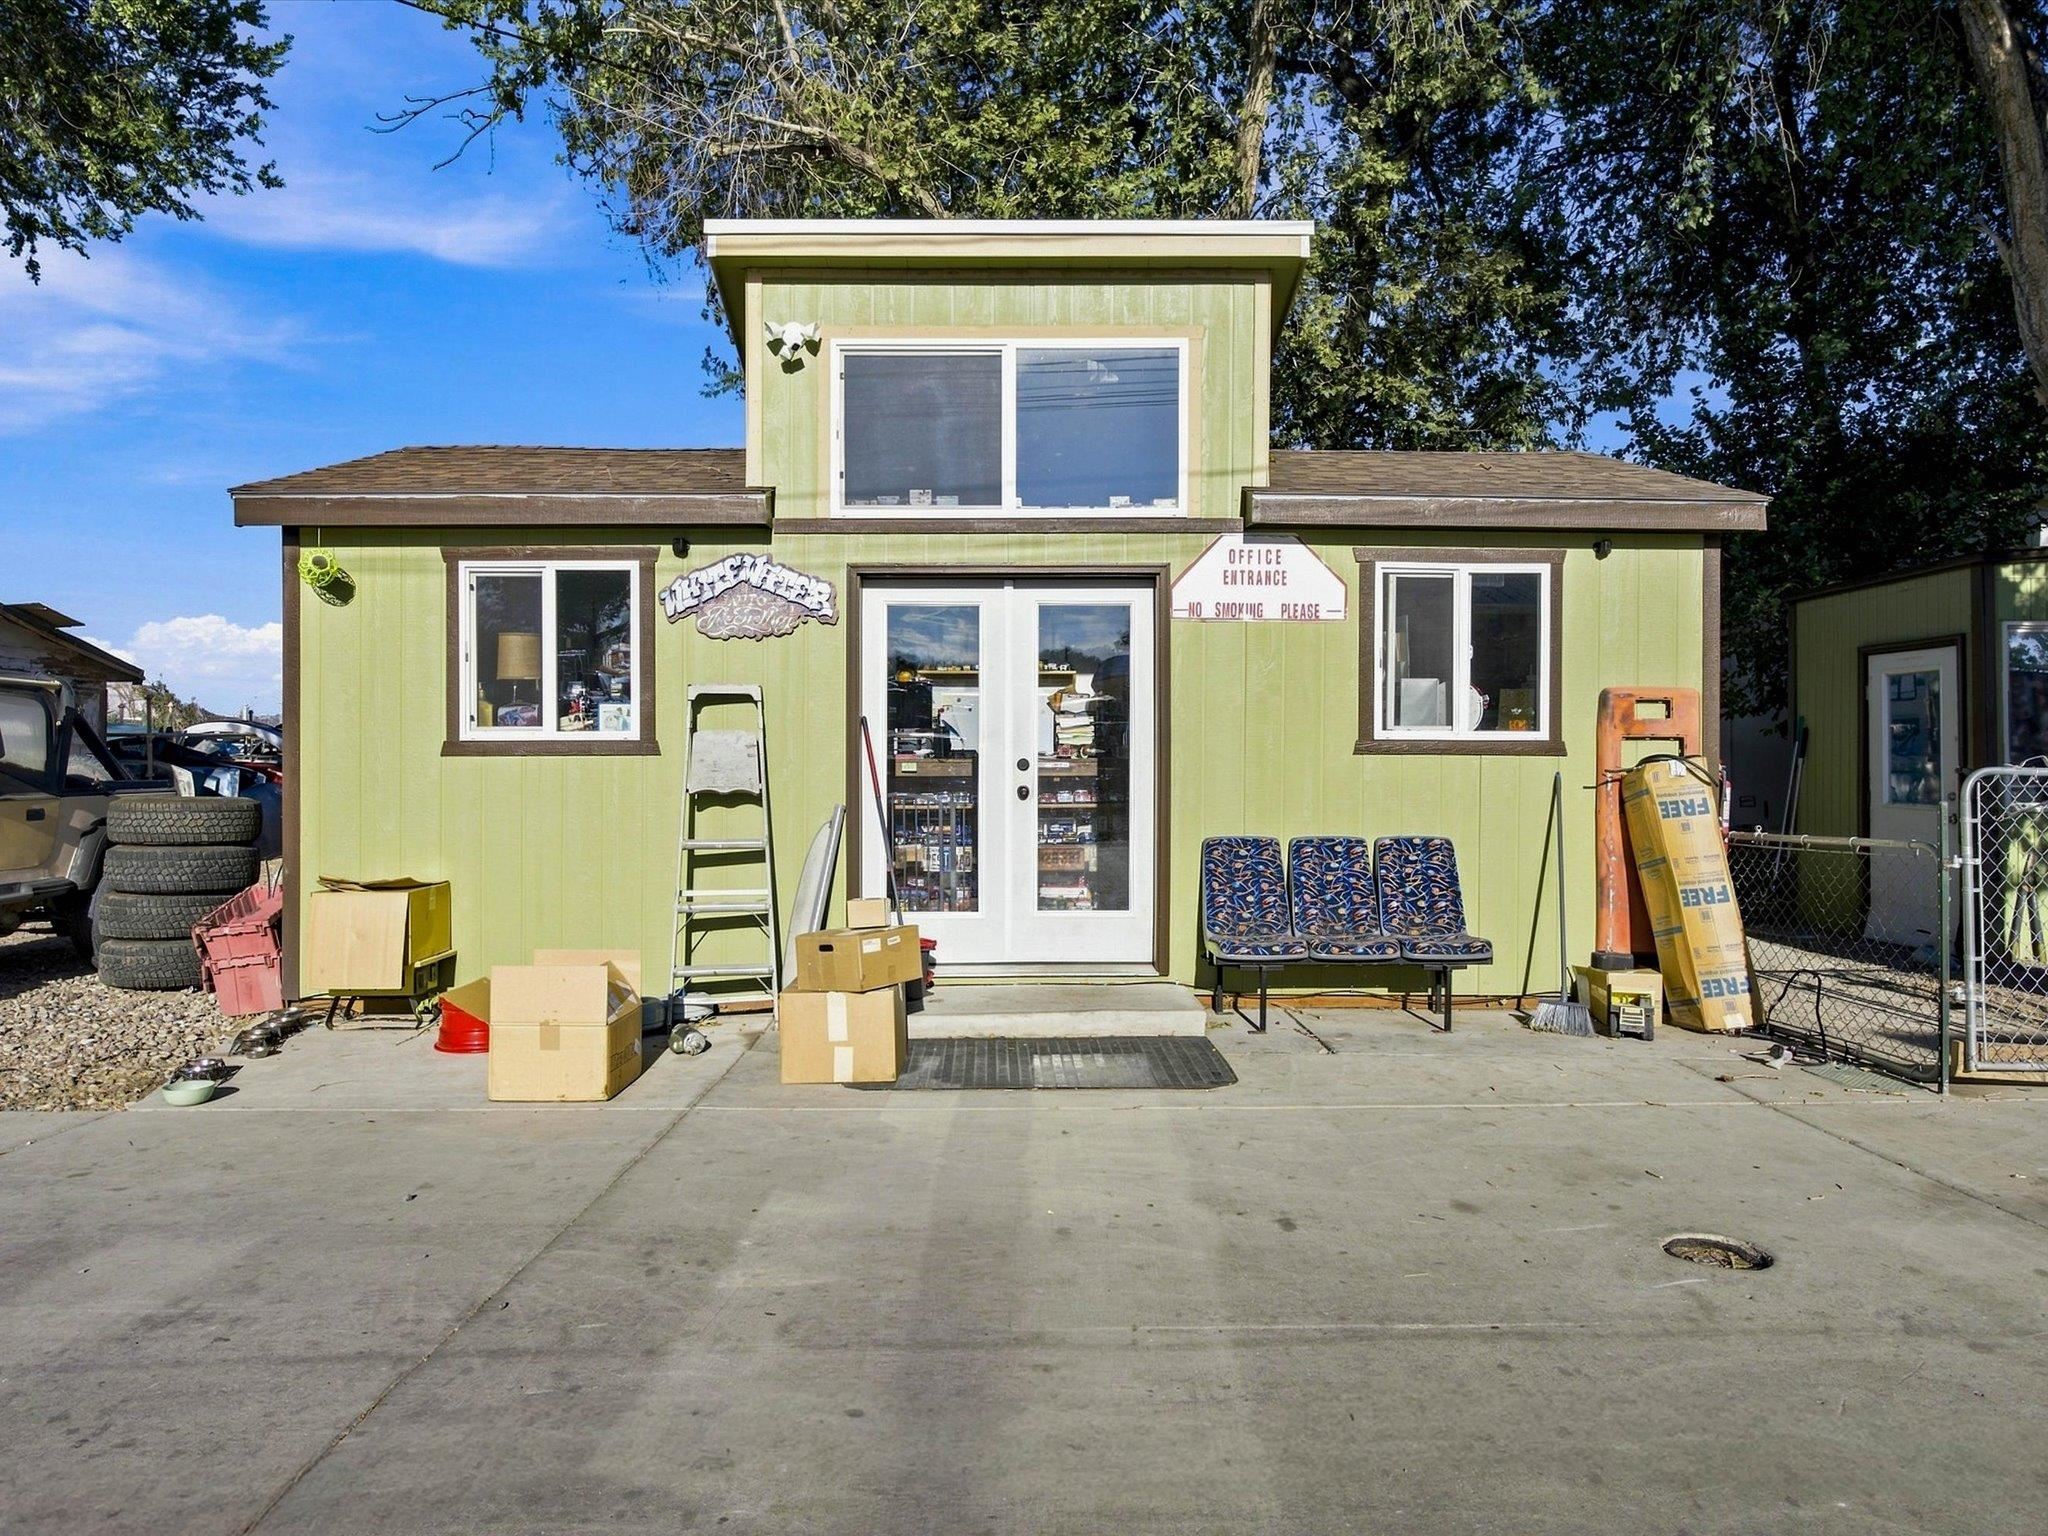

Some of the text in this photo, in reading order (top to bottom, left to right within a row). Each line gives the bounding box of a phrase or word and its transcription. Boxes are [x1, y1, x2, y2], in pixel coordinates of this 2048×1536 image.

[1228, 548, 1283, 565] OFFICE
[1222, 569, 1289, 587] ENTRANCE
[1188, 601, 1321, 620] NO SMOKING PLEASE
[1658, 797, 1711, 819] FREE
[1680, 885, 1731, 907] FREE
[1702, 976, 1751, 999] FREE
